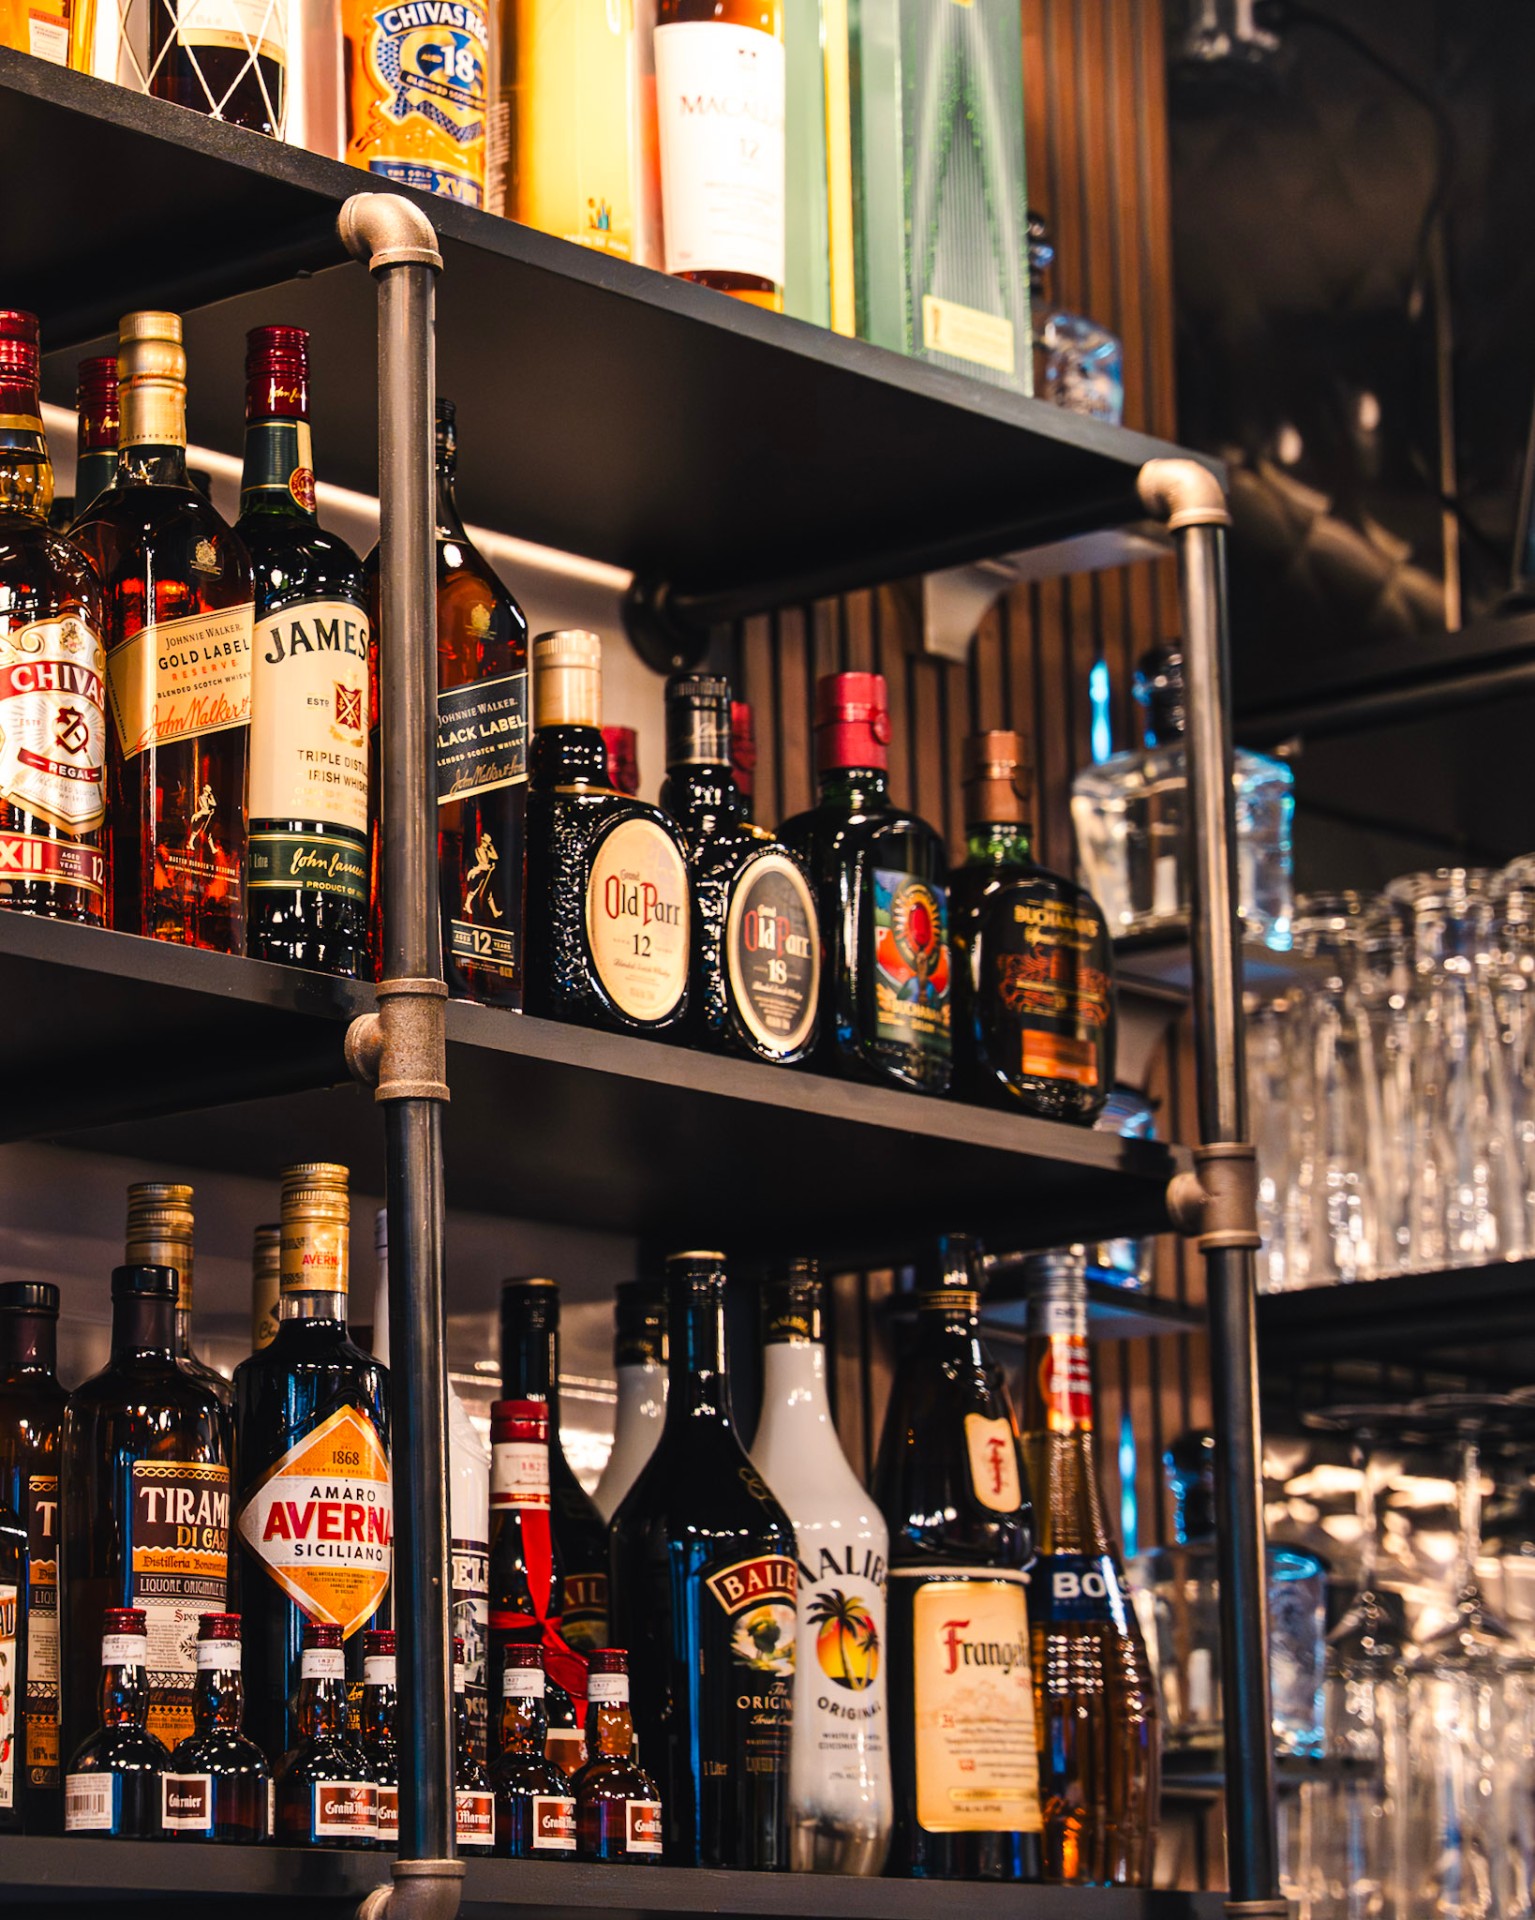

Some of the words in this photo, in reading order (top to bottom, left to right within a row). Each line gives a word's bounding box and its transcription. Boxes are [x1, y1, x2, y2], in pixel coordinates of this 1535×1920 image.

[383, 2, 464, 33] CHIVAS
[440, 45, 476, 83] 18
[165, 631, 205, 650] JOHNNIE
[205, 623, 242, 638] WALKER
[265, 618, 367, 664] JAMES
[158, 650, 199, 671] GOLD
[204, 638, 250, 660] LABEL
[171, 659, 237, 681] RESERVE
[10, 663, 106, 712] CHIVAS
[157, 686, 192, 699] BLENDED
[194, 678, 223, 691] SCOTCH
[438, 706, 478, 728] JOHNNIE
[478, 697, 517, 715] WALKER
[437, 725, 478, 749] LACK
[479, 714, 527, 738] LABEL
[297, 749, 341, 766] TRIPLE
[437, 753, 466, 767] LENDED
[467, 745, 496, 759] SCOTCH
[48, 762, 90, 780] REGAL
[308, 769, 341, 785] IRISH
[0, 841, 43, 871] XII
[60, 861, 82, 871] YEARS
[61, 852, 81, 861] AGED
[290, 847, 328, 875] John
[92, 855, 104, 885] 12
[306, 880, 346, 894] PRODUCT
[605, 874, 639, 920] Old
[639, 881, 681, 927] Parr
[471, 929, 493, 955] 12
[744, 909, 776, 953] Old
[632, 933, 652, 958] 12
[767, 958, 788, 985] 18
[332, 1450, 360, 1466] 1868
[309, 1485, 376, 1502] AMARO
[176, 1525, 198, 1548] DI
[142, 1555, 191, 1569] Distilleria
[294, 1543, 383, 1562] SICILIANO
[139, 1578, 182, 1593] LIQUORE
[816, 1696, 883, 1721] ORIGINAL
[324, 1800, 353, 1815] Grand
